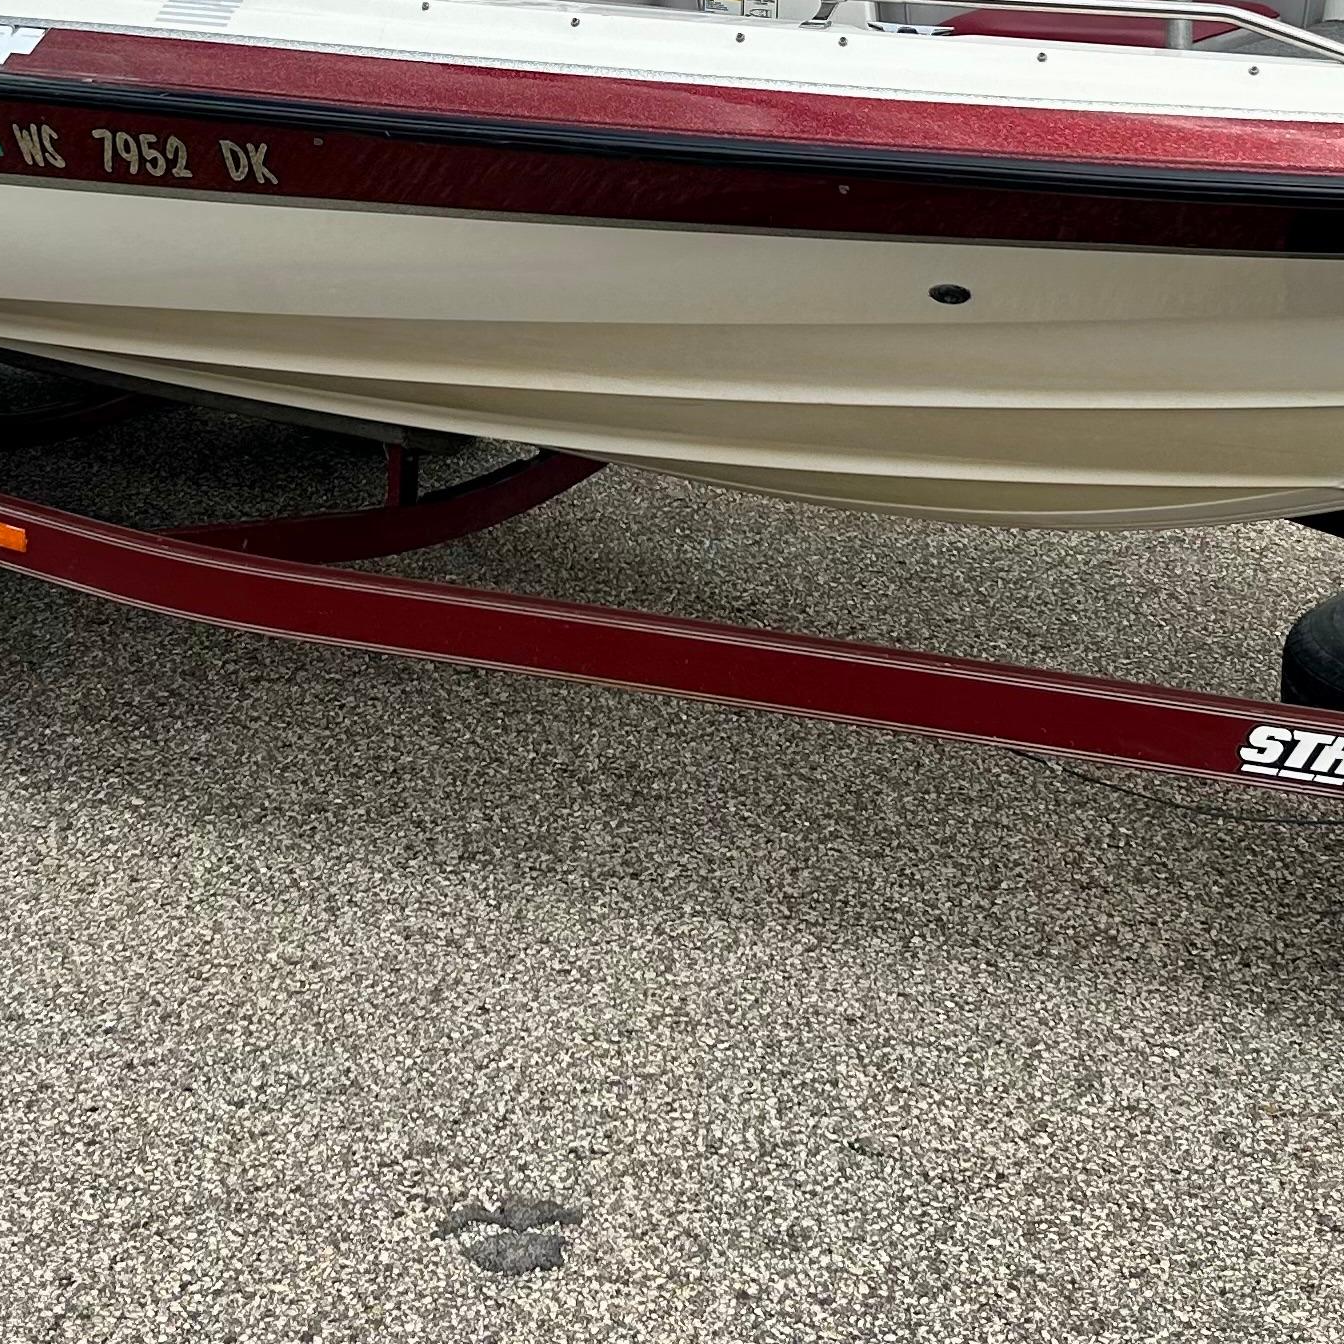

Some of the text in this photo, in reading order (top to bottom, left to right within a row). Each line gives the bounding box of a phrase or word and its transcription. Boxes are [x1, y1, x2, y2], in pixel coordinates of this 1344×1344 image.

[12, 122, 279, 186] WS 7952 DK
